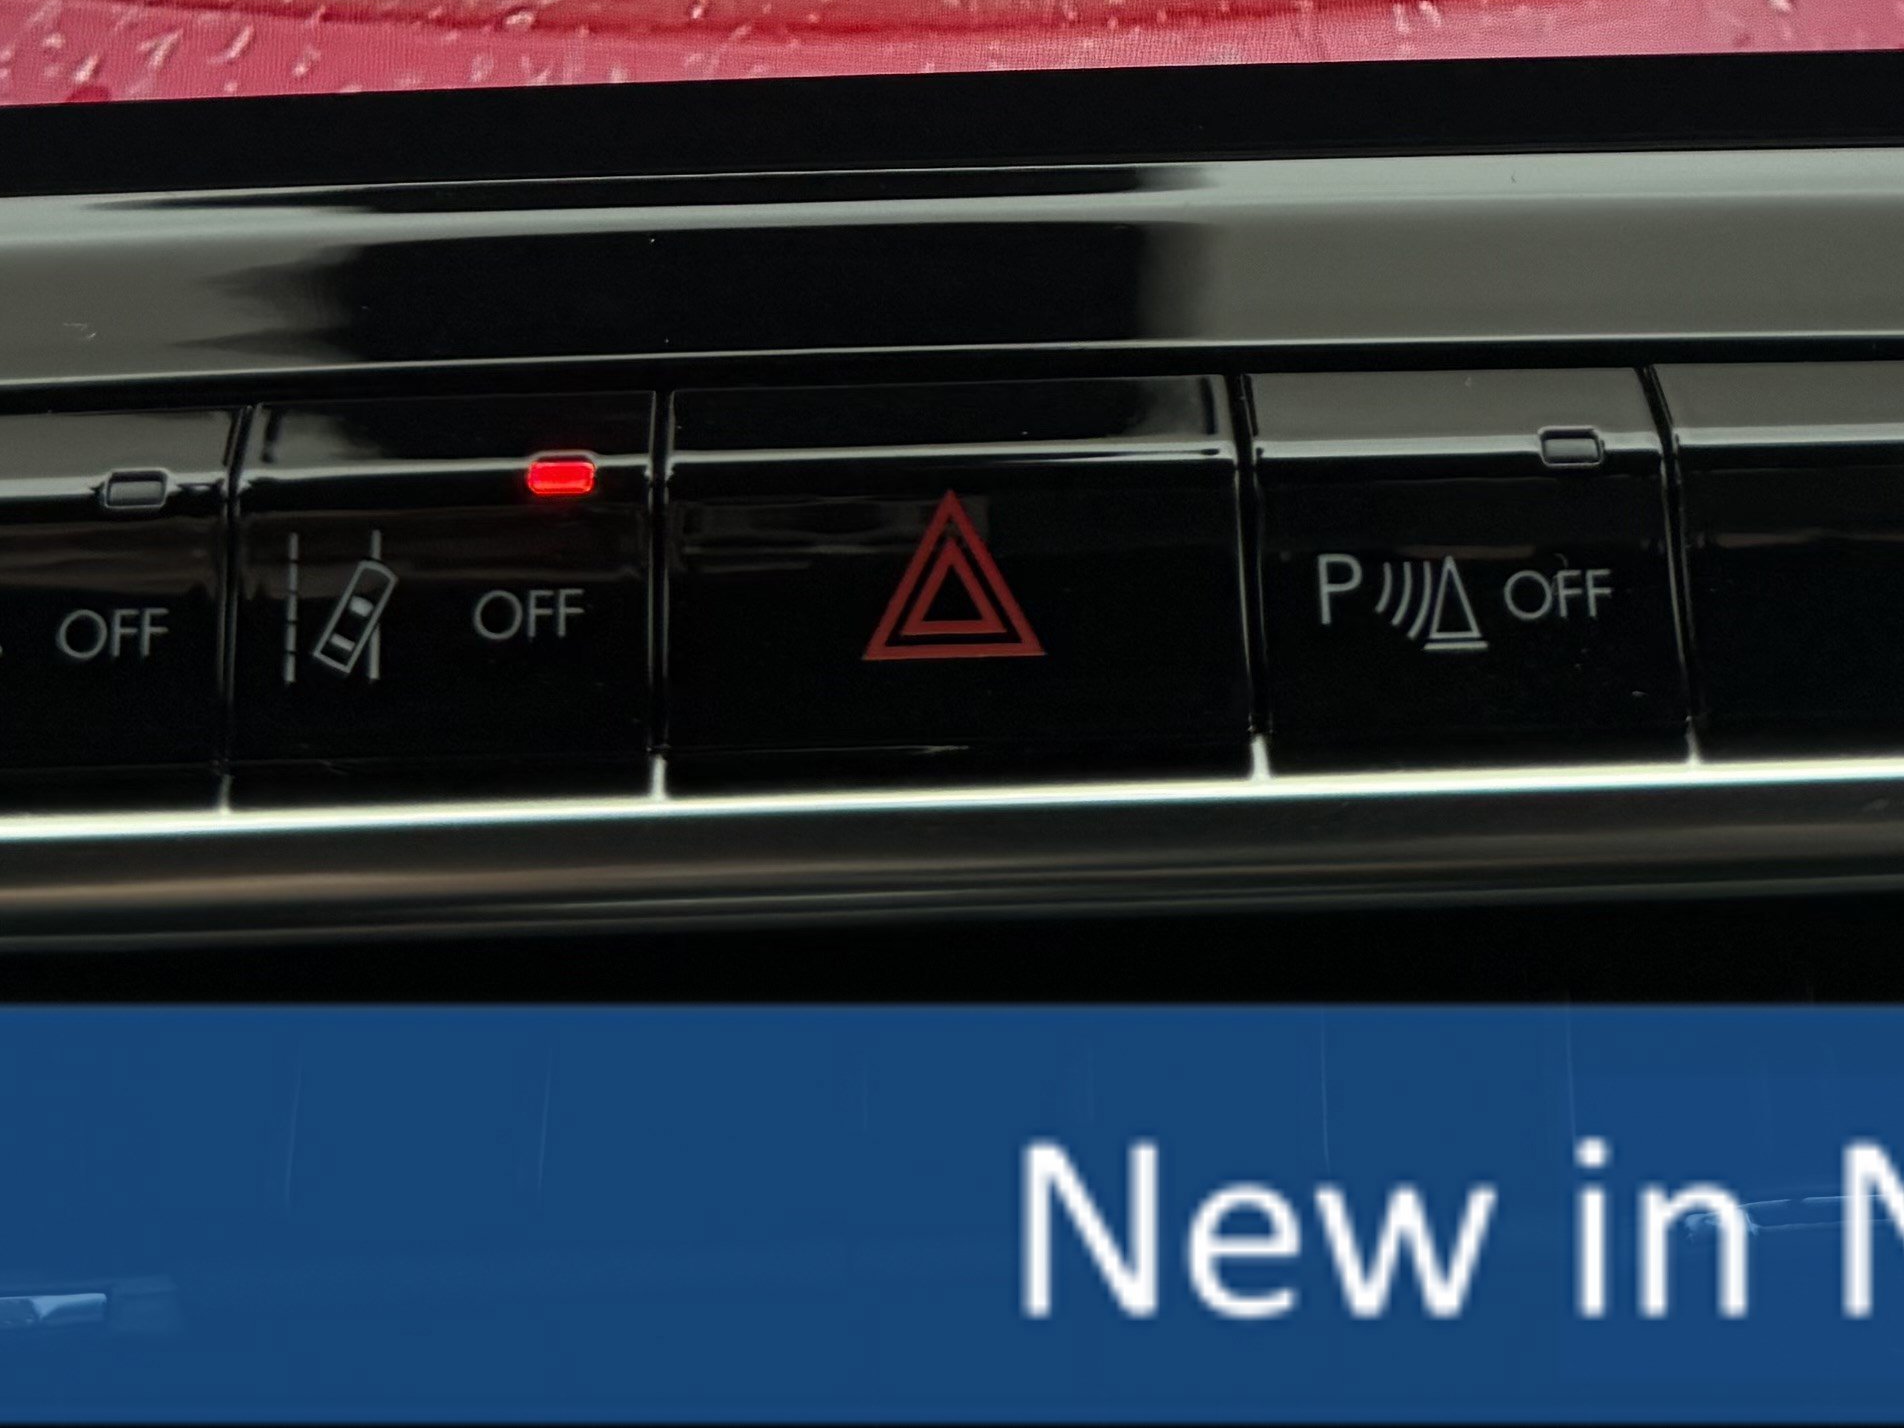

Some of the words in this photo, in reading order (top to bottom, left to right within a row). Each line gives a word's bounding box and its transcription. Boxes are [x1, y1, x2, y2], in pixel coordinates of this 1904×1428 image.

[471, 586, 586, 642] OFF
[1315, 552, 1364, 626] P
[1502, 566, 1613, 623] OFF
[55, 606, 170, 661] OFF
